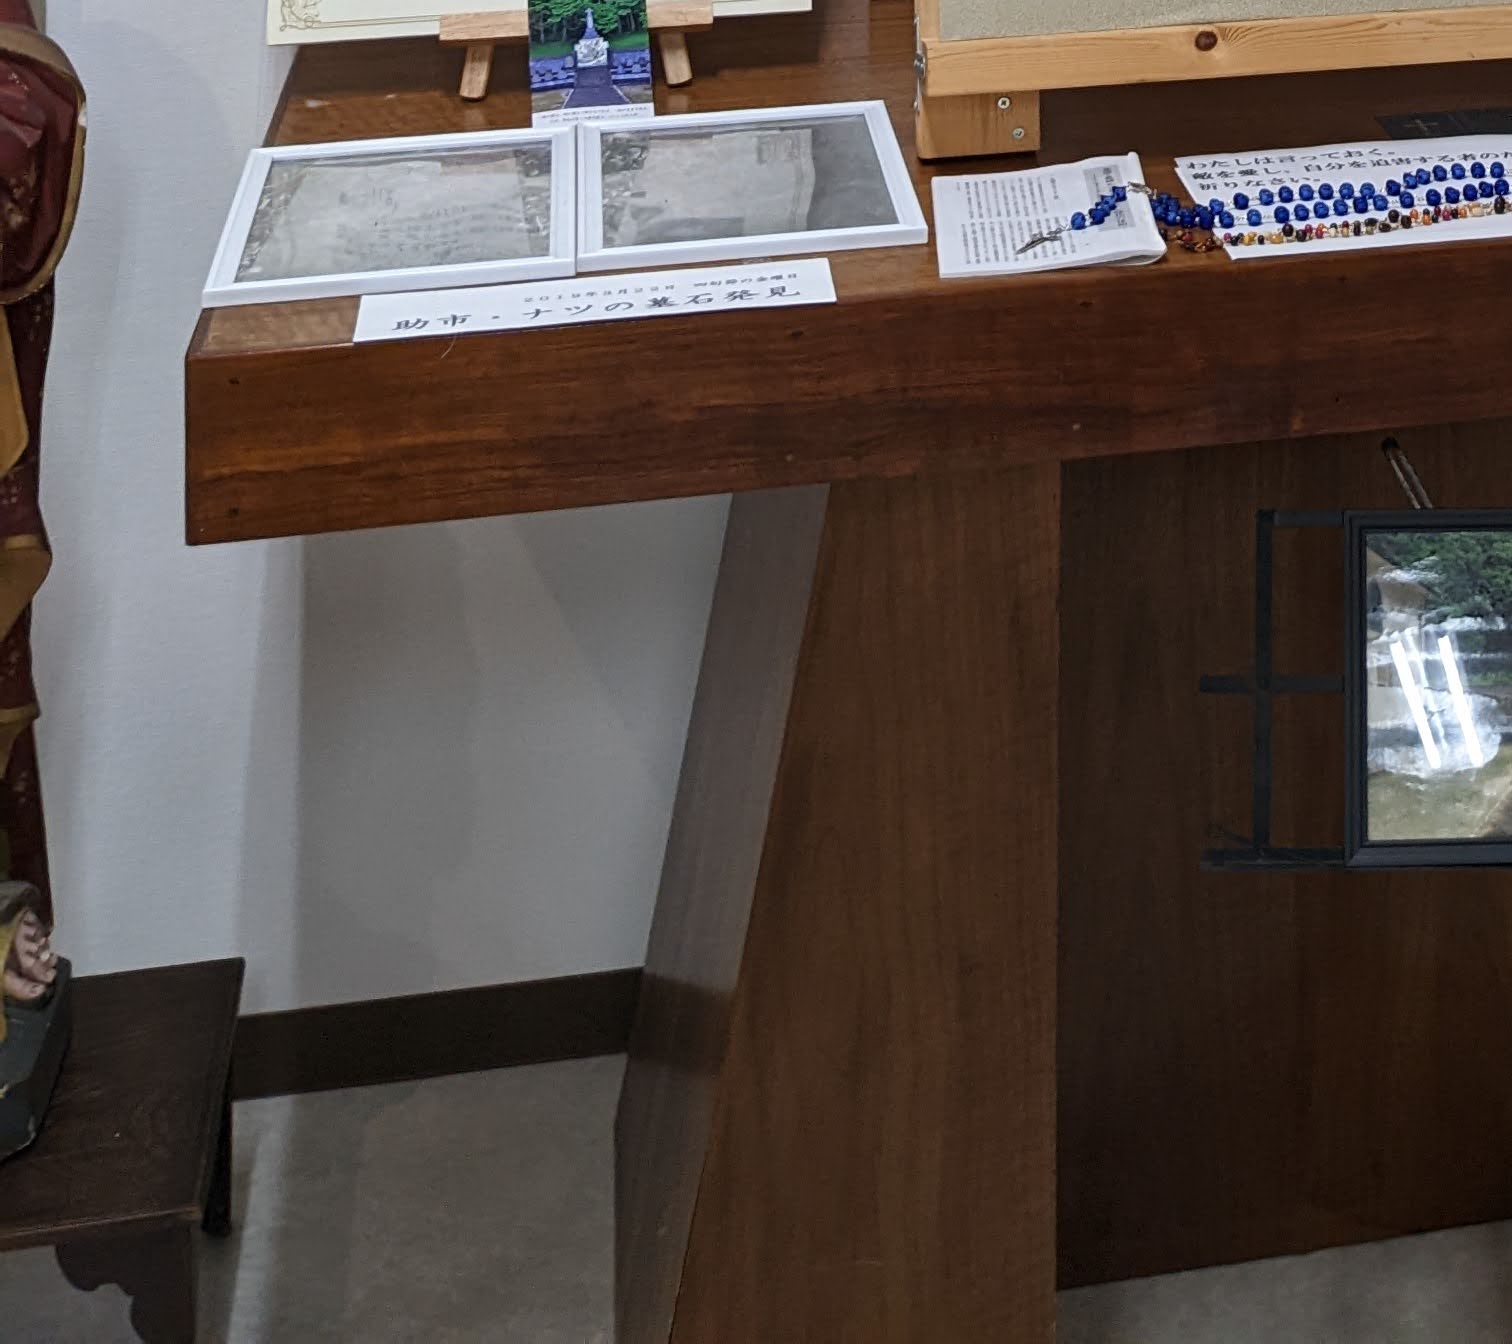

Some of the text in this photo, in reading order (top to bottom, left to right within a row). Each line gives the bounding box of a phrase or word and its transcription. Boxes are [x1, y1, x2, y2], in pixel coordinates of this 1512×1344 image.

[1186, 149, 1398, 169] わたしは言っておく。
[393, 285, 801, 331] 助市・ナツの墓石発見
